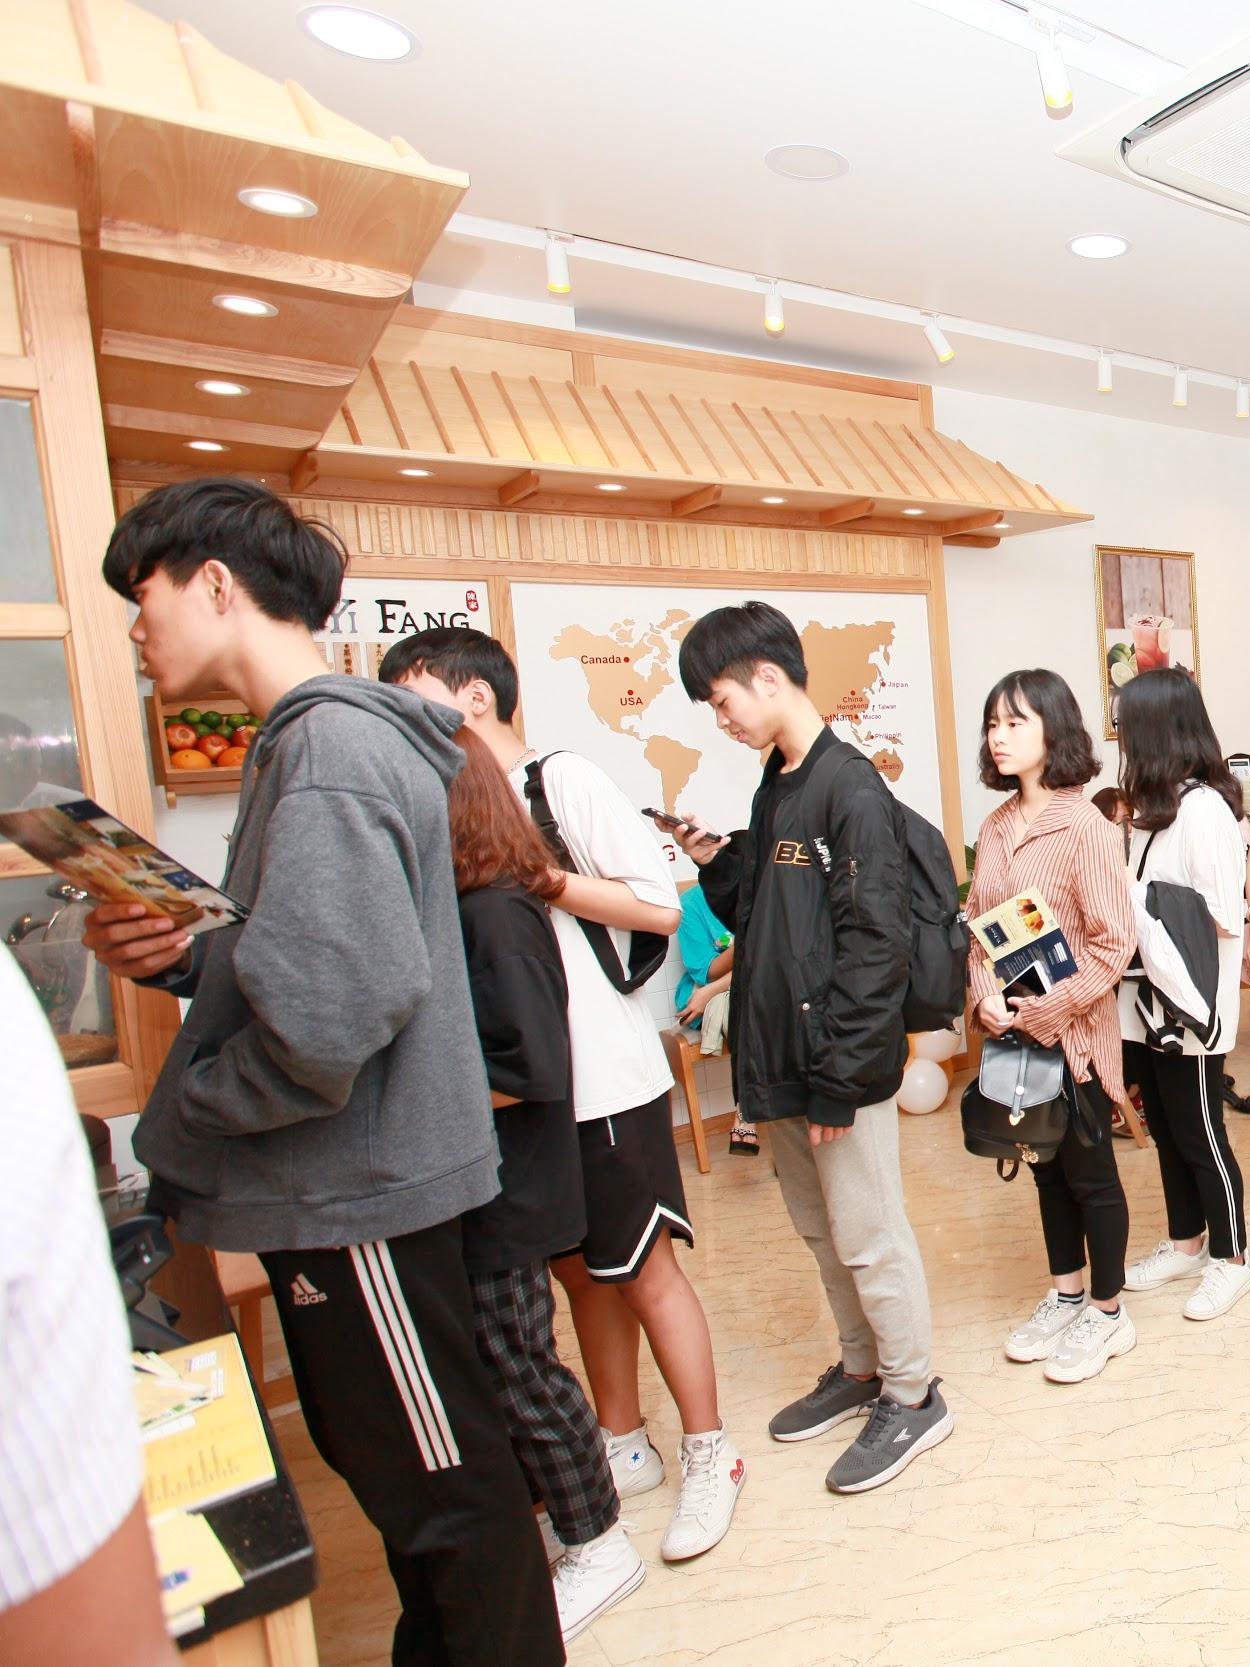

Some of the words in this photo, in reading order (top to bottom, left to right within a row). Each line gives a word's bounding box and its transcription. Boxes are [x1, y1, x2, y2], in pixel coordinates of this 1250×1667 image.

[581, 655, 621, 664] Canada
[620, 697, 643, 706] USA
[820, 713, 854, 723] ietNam
